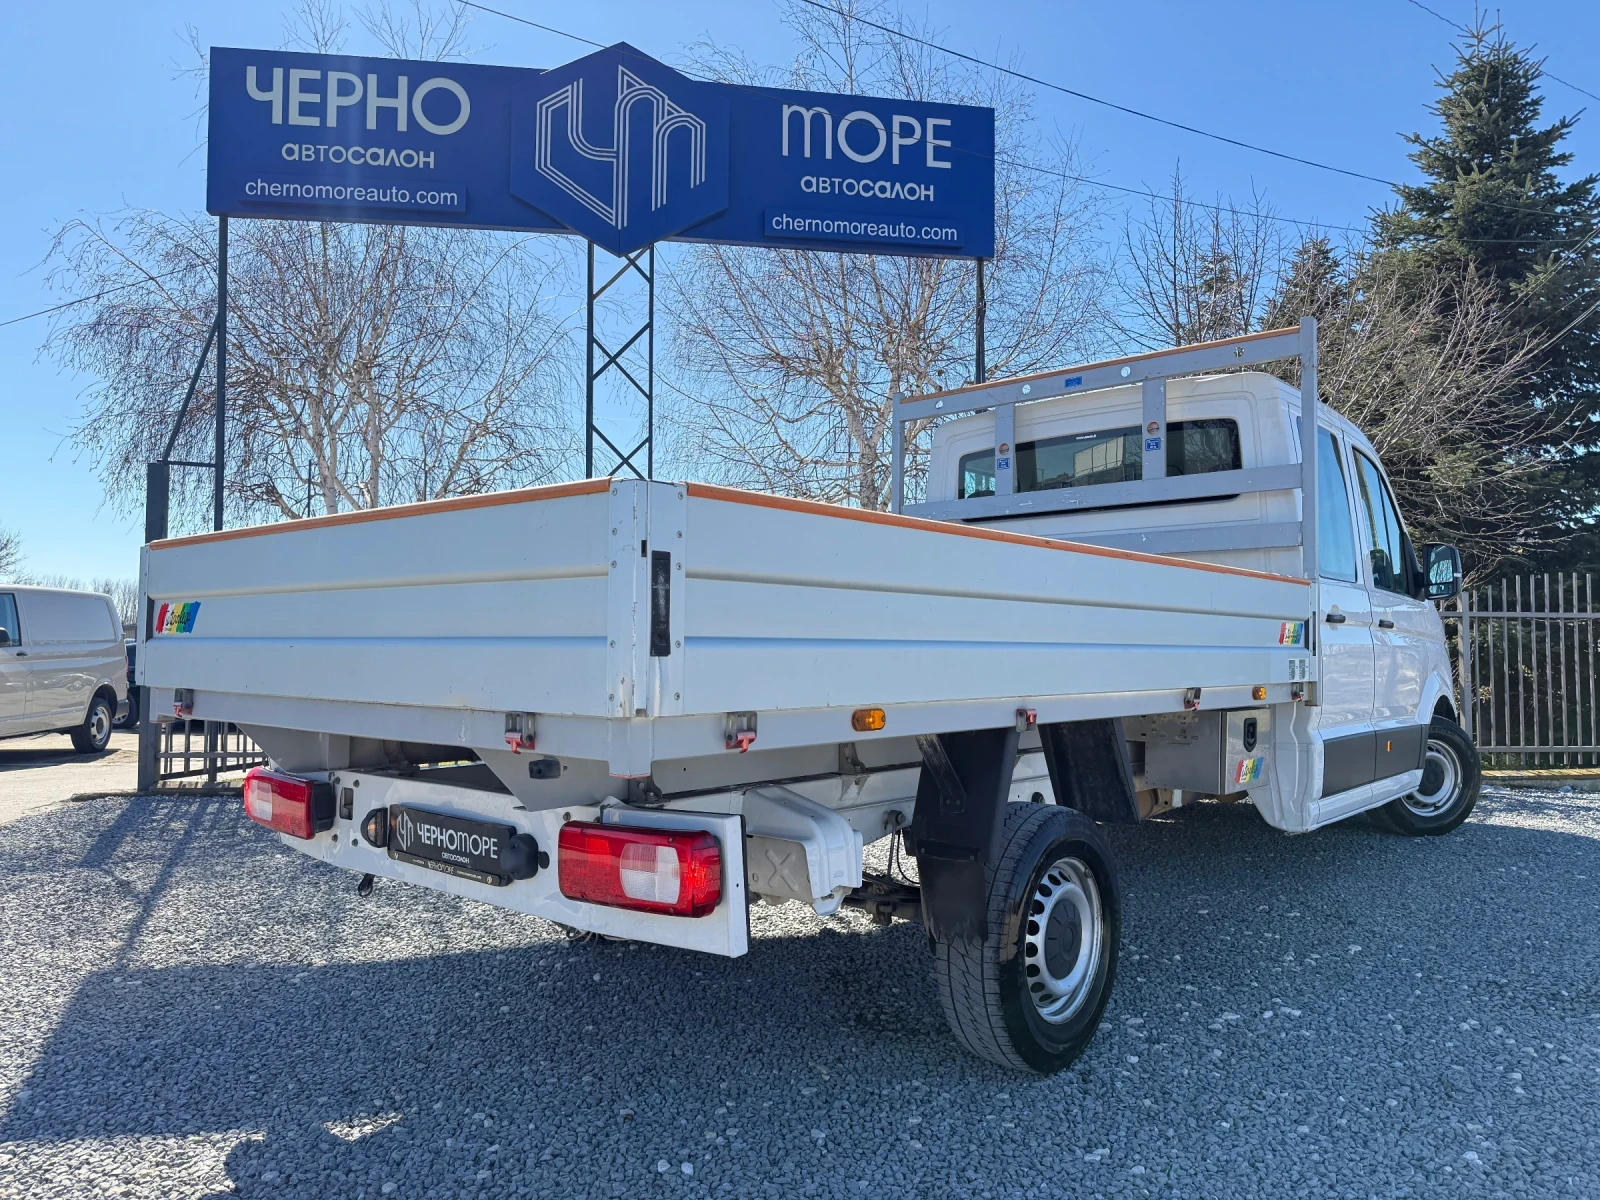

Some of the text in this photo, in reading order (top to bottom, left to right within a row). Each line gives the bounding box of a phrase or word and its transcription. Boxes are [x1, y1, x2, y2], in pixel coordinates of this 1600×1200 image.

[246, 65, 470, 135] ЧЕРНО
[281, 143, 435, 169] автосалон
[245, 178, 458, 206] chernomoreauto.com
[800, 175, 935, 202] автосалон
[772, 213, 957, 241] chernomoreauto.com
